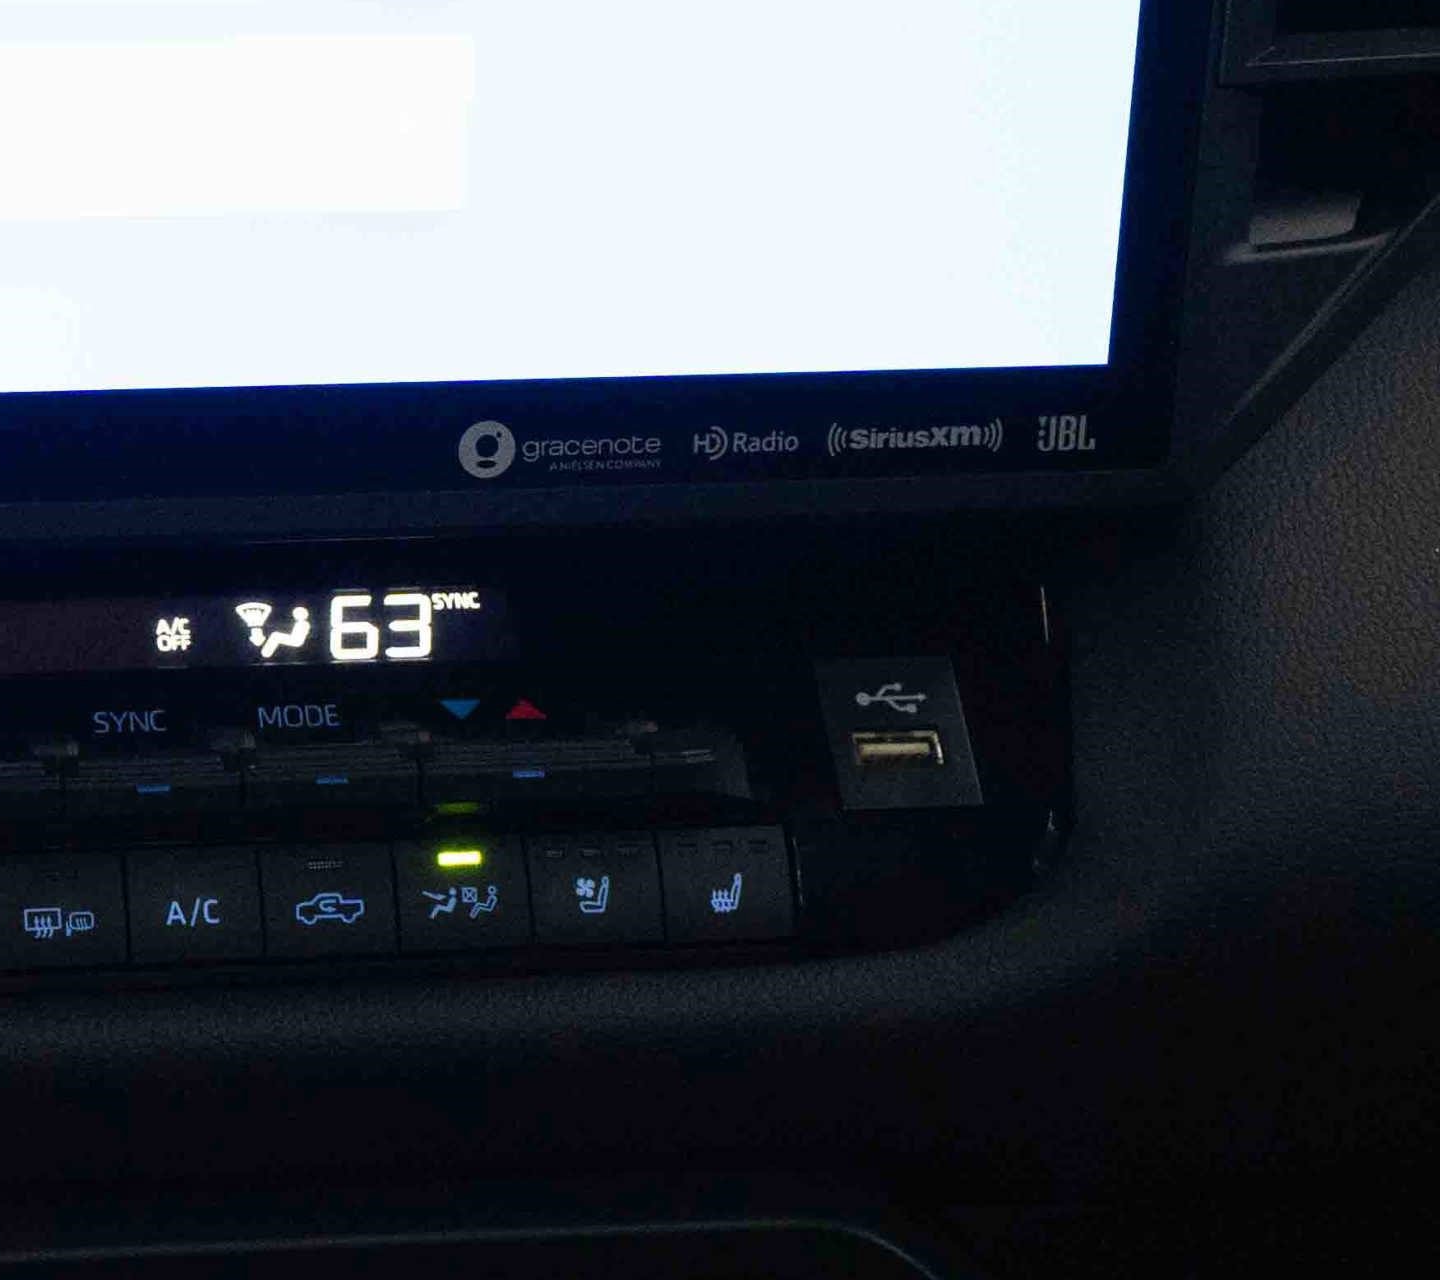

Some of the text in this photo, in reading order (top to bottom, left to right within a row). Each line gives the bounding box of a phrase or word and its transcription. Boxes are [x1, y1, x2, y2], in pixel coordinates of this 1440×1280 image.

[522, 436, 662, 463] gracenote
[733, 432, 799, 454] Radio
[156, 617, 190, 636] A/C
[329, 591, 481, 660] 63 SYNC
[157, 635, 192, 652] OFF
[92, 709, 168, 734] SYNC
[258, 704, 341, 729] MODE
[166, 898, 220, 926] A/C
